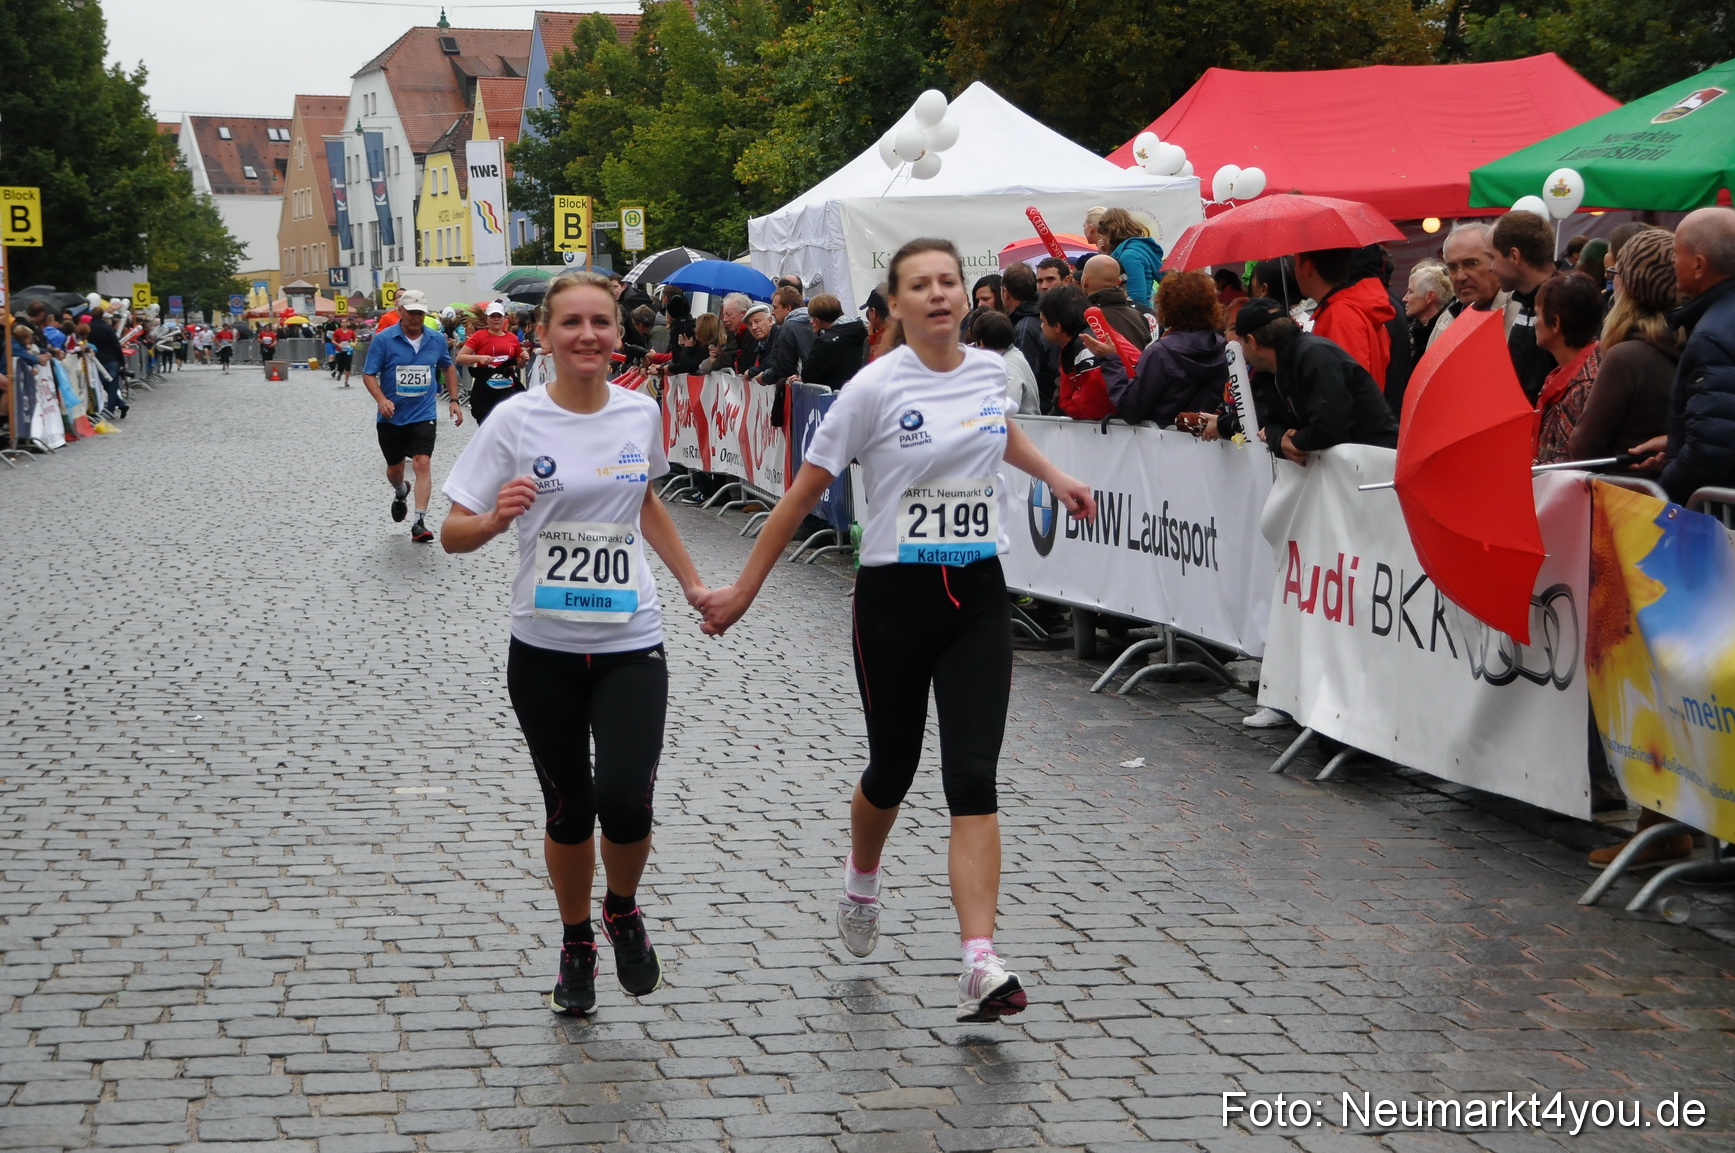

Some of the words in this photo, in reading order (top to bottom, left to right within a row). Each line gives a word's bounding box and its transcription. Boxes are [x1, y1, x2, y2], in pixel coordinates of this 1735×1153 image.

[3, 189, 36, 201] Block
[559, 198, 588, 209] Block
[10, 205, 31, 232] B
[564, 213, 582, 239] B
[136, 290, 147, 303] C
[338, 301, 346, 311] D
[400, 373, 427, 385] 2251
[899, 430, 931, 444] PARTL
[900, 438, 932, 449] Neumarkt
[937, 488, 982, 498] Neumarkt
[908, 502, 989, 538] 2199
[539, 530, 576, 542] PARTL
[578, 533, 624, 544] Neumarkt
[1127, 493, 1219, 576] Laufsport
[917, 549, 981, 565] Katarzyna
[546, 545, 630, 585] 2200
[1282, 540, 1360, 627] Audi
[564, 592, 612, 608] Erwina
